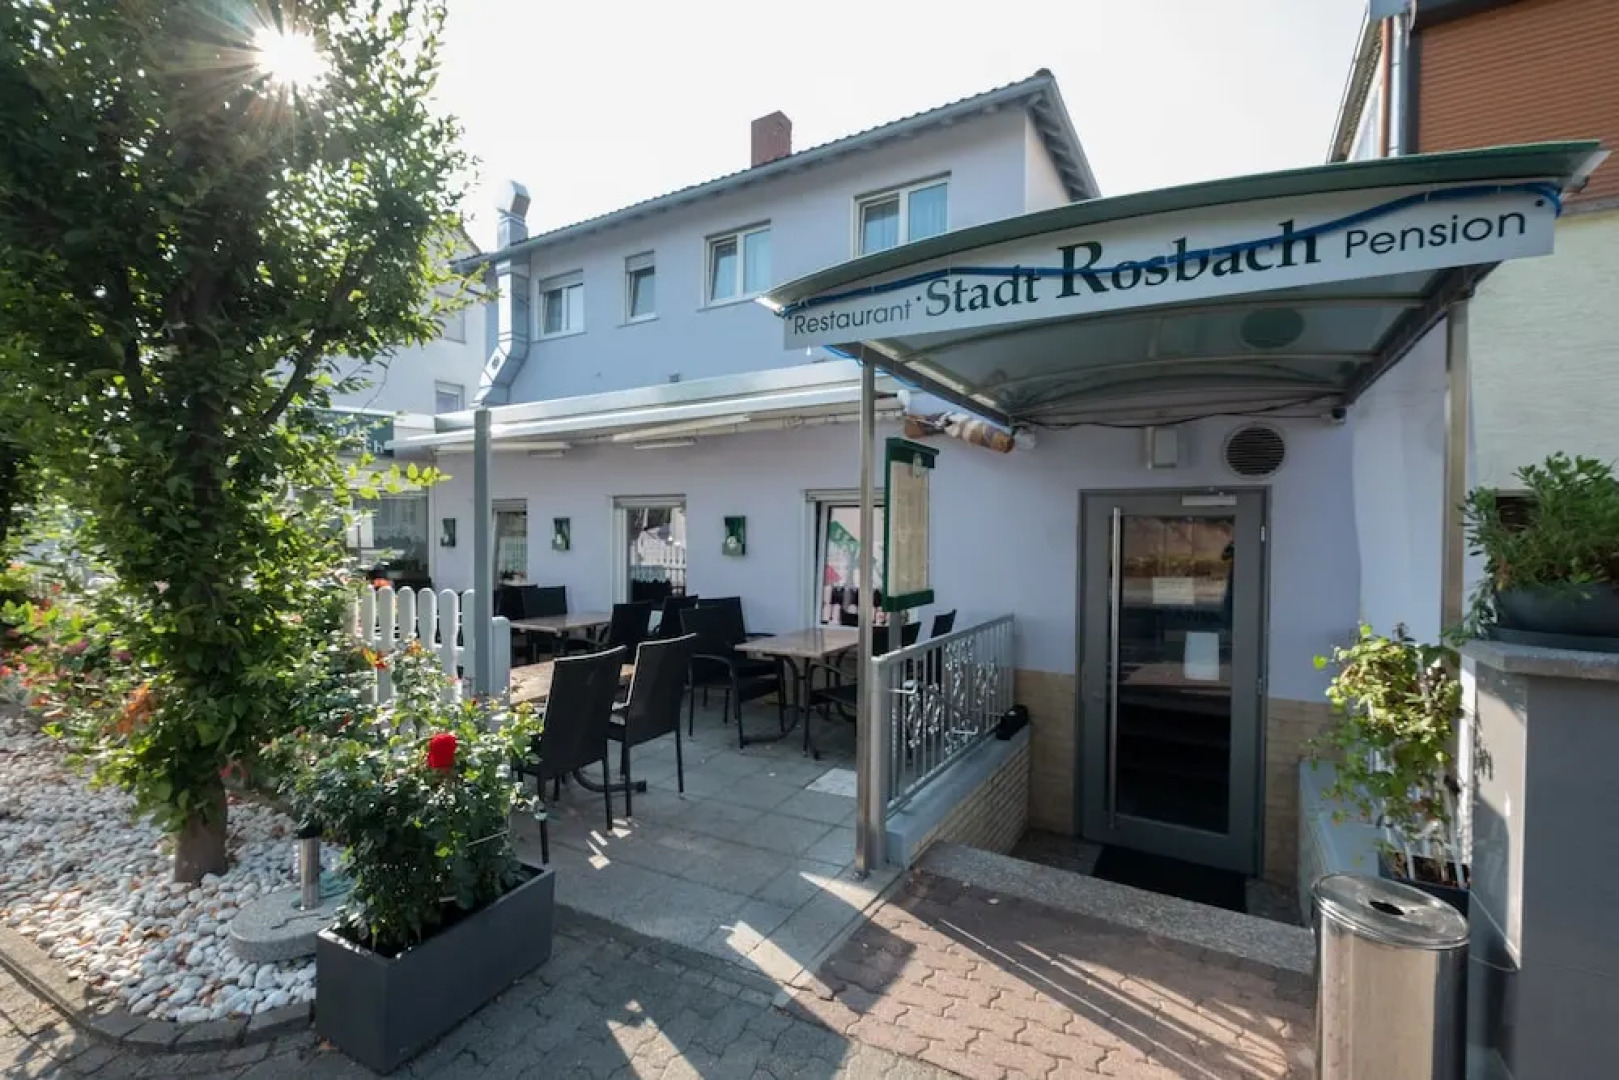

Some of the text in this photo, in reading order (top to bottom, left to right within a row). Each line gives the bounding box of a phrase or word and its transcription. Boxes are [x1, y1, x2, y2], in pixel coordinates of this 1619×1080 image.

[794, 211, 1526, 335] Restaurant Stadt Rosbach Pension
